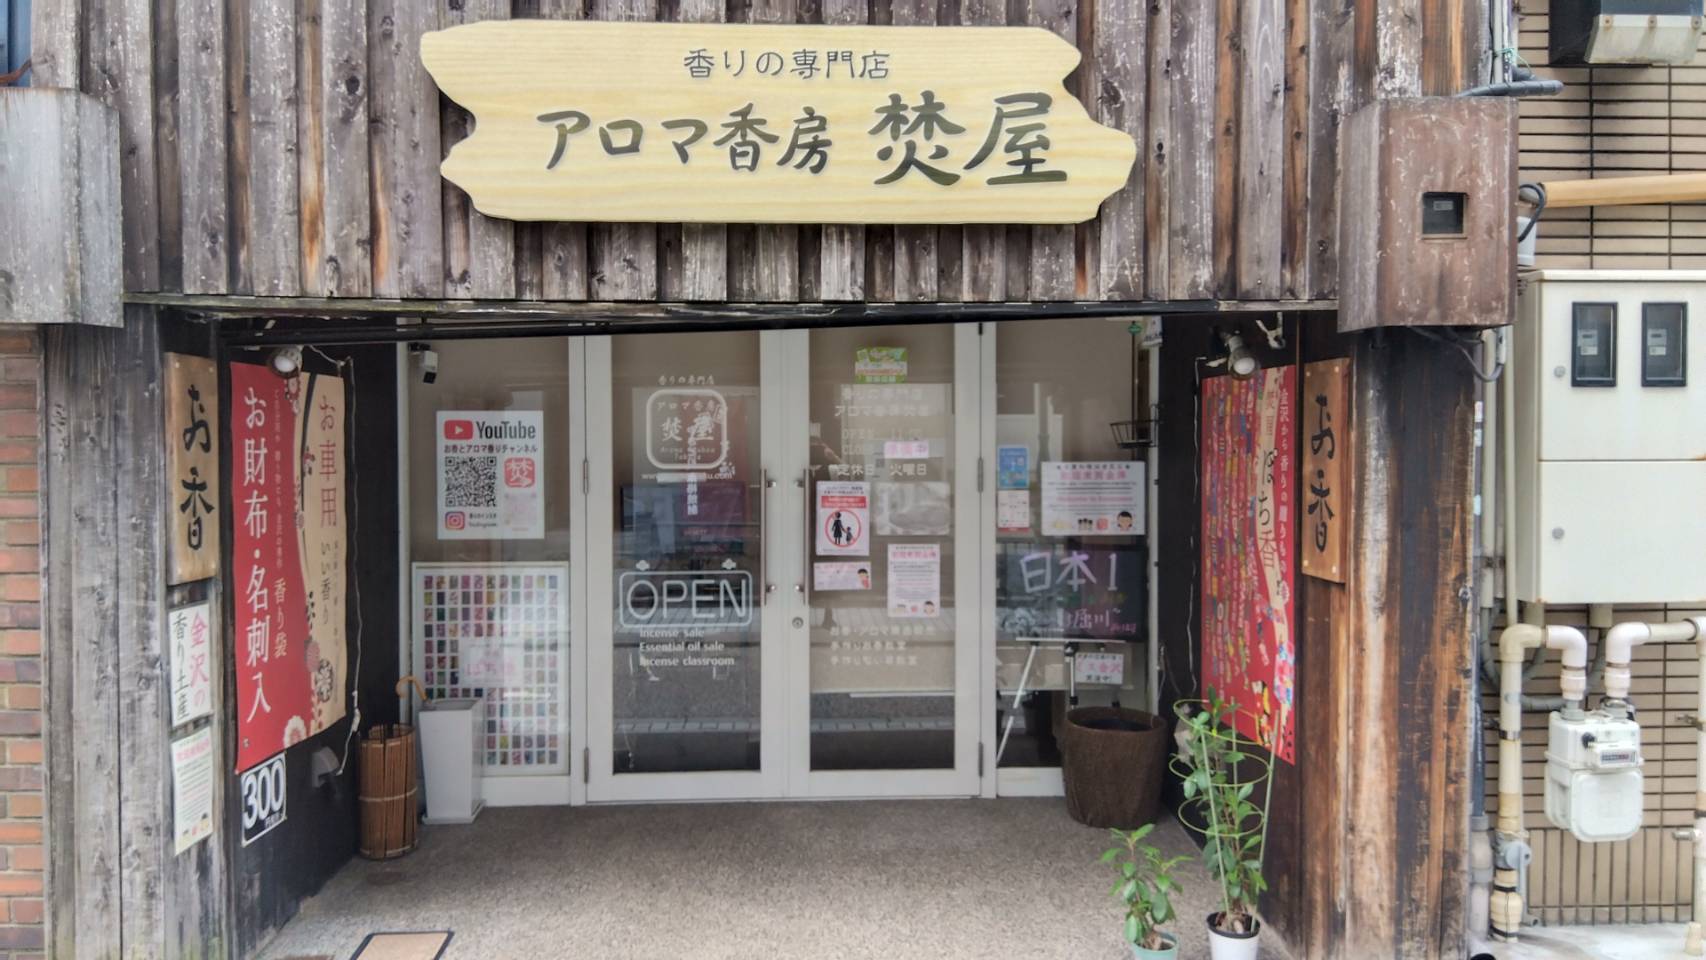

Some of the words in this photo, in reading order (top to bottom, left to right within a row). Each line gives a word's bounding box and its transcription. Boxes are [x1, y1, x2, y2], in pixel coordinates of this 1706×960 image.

[684, 48, 890, 80] 香りの専門店
[536, 102, 833, 174] アロマ香房
[867, 90, 1067, 186] 焚屋
[475, 420, 537, 440] YouTube
[179, 384, 215, 551] お香
[318, 395, 337, 527] お車用
[837, 464, 875, 476] 定休日
[888, 463, 928, 477] 火曜日
[1307, 393, 1335, 553] お香
[243, 386, 273, 723] お財布・名刺入
[274, 577, 288, 659] 香り袋
[627, 579, 746, 620] OPEN
[640, 627, 679, 638] Incense
[684, 627, 705, 638] sale
[640, 641, 685, 652] Essential
[688, 641, 701, 652] oil
[704, 641, 725, 652] sale
[640, 655, 679, 666] Incense
[683, 655, 735, 666] classroom
[244, 760, 285, 831] 300
